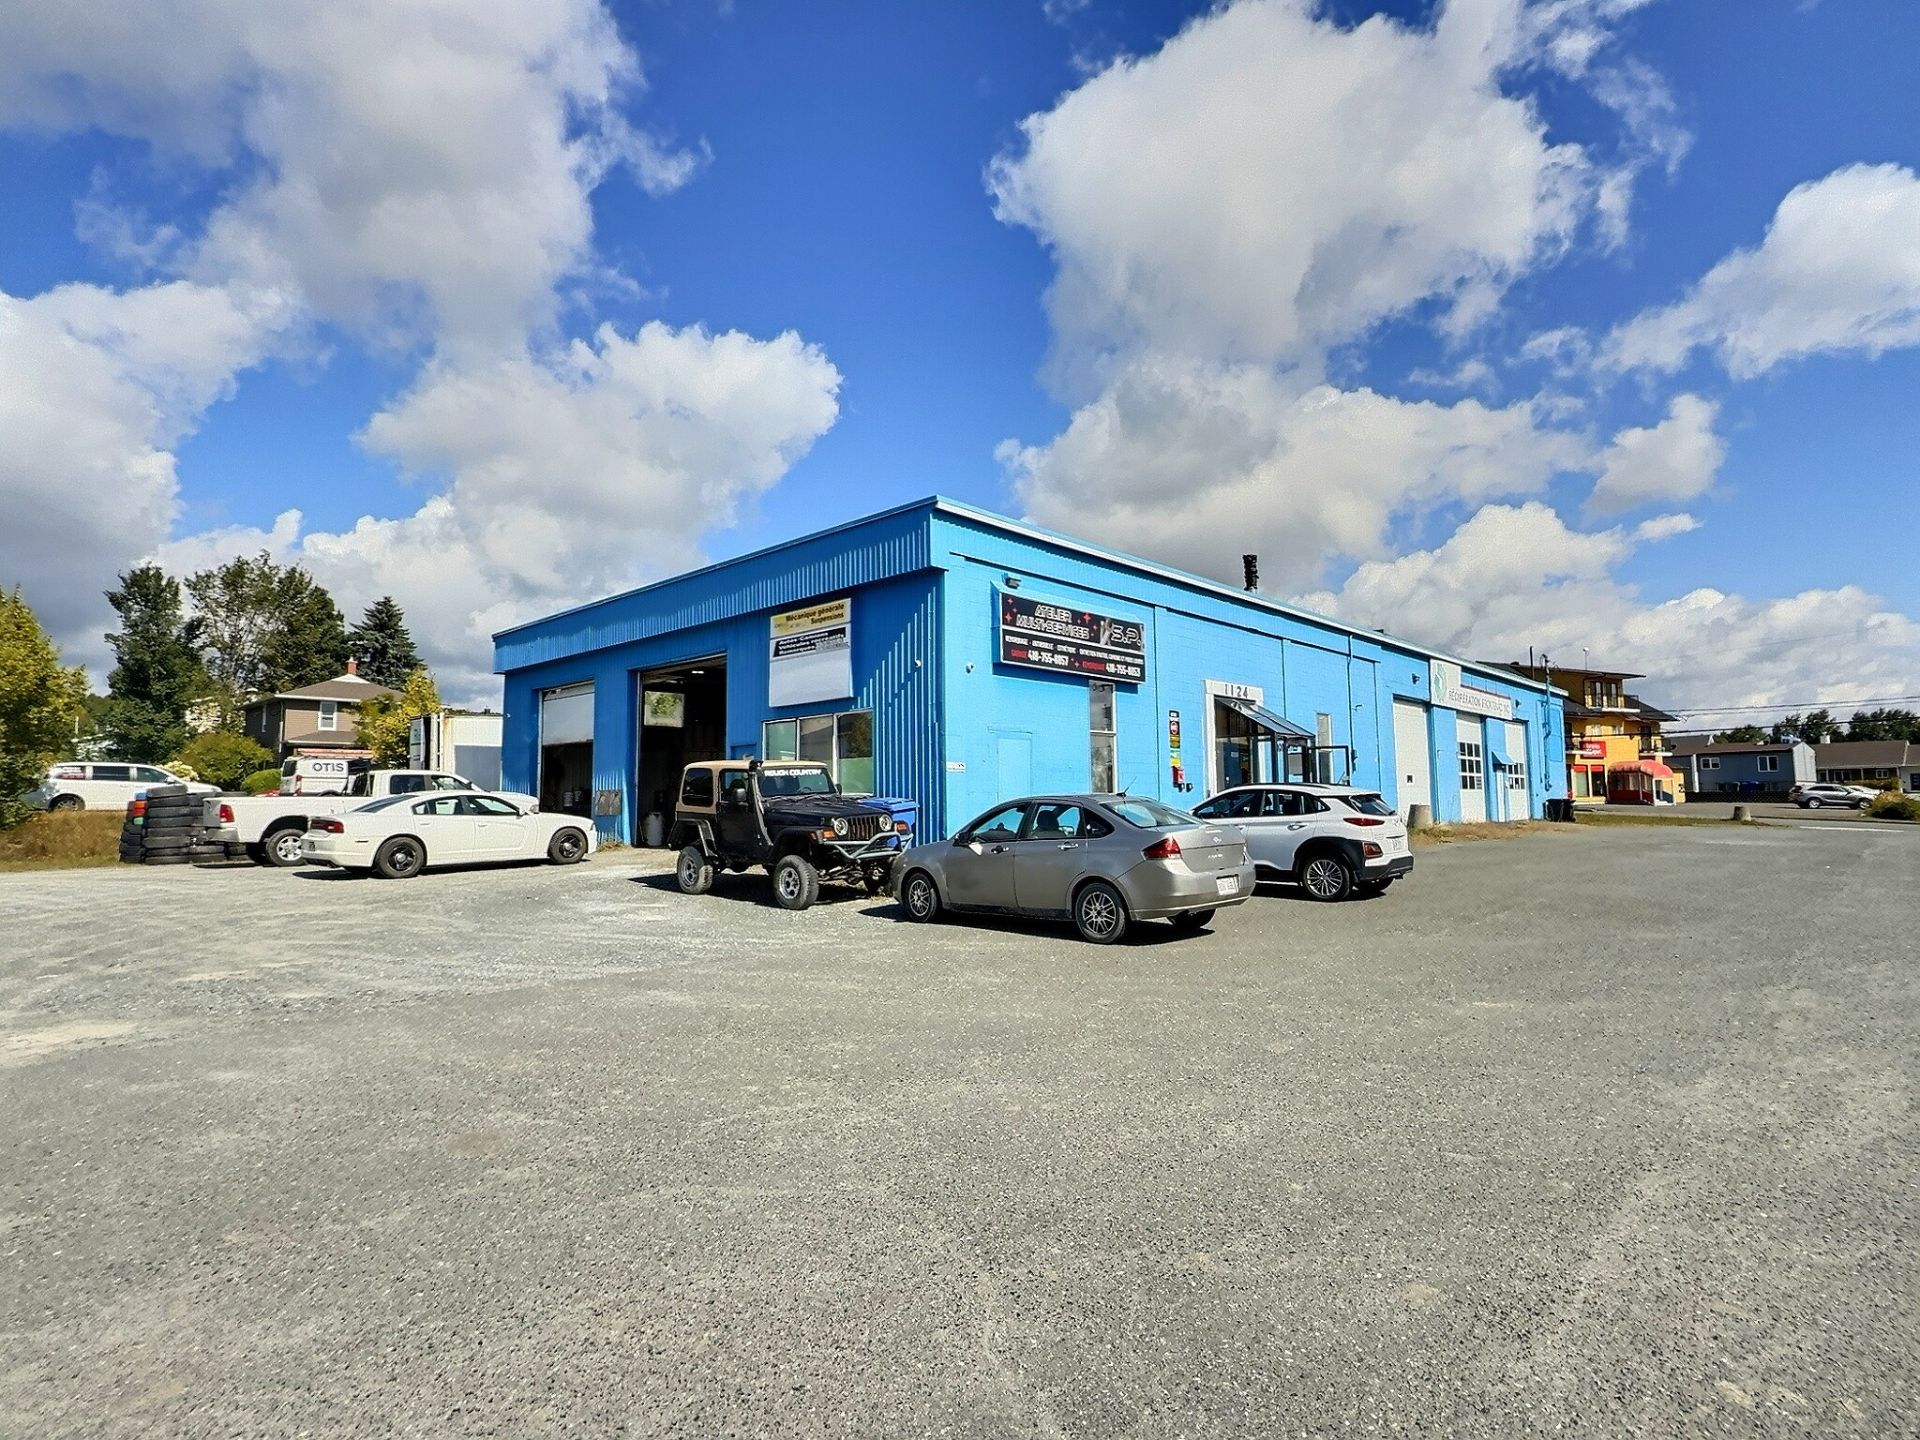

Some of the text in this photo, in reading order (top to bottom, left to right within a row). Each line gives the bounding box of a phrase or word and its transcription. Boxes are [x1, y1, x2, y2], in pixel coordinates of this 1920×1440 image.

[1034, 604, 1072, 623] ATELIER
[1016, 614, 1090, 640] MULTI-SERVICES
[1224, 683, 1249, 699] 1124
[312, 762, 345, 773] OTIS
[764, 768, 822, 777] ROUGH COUNTRY
